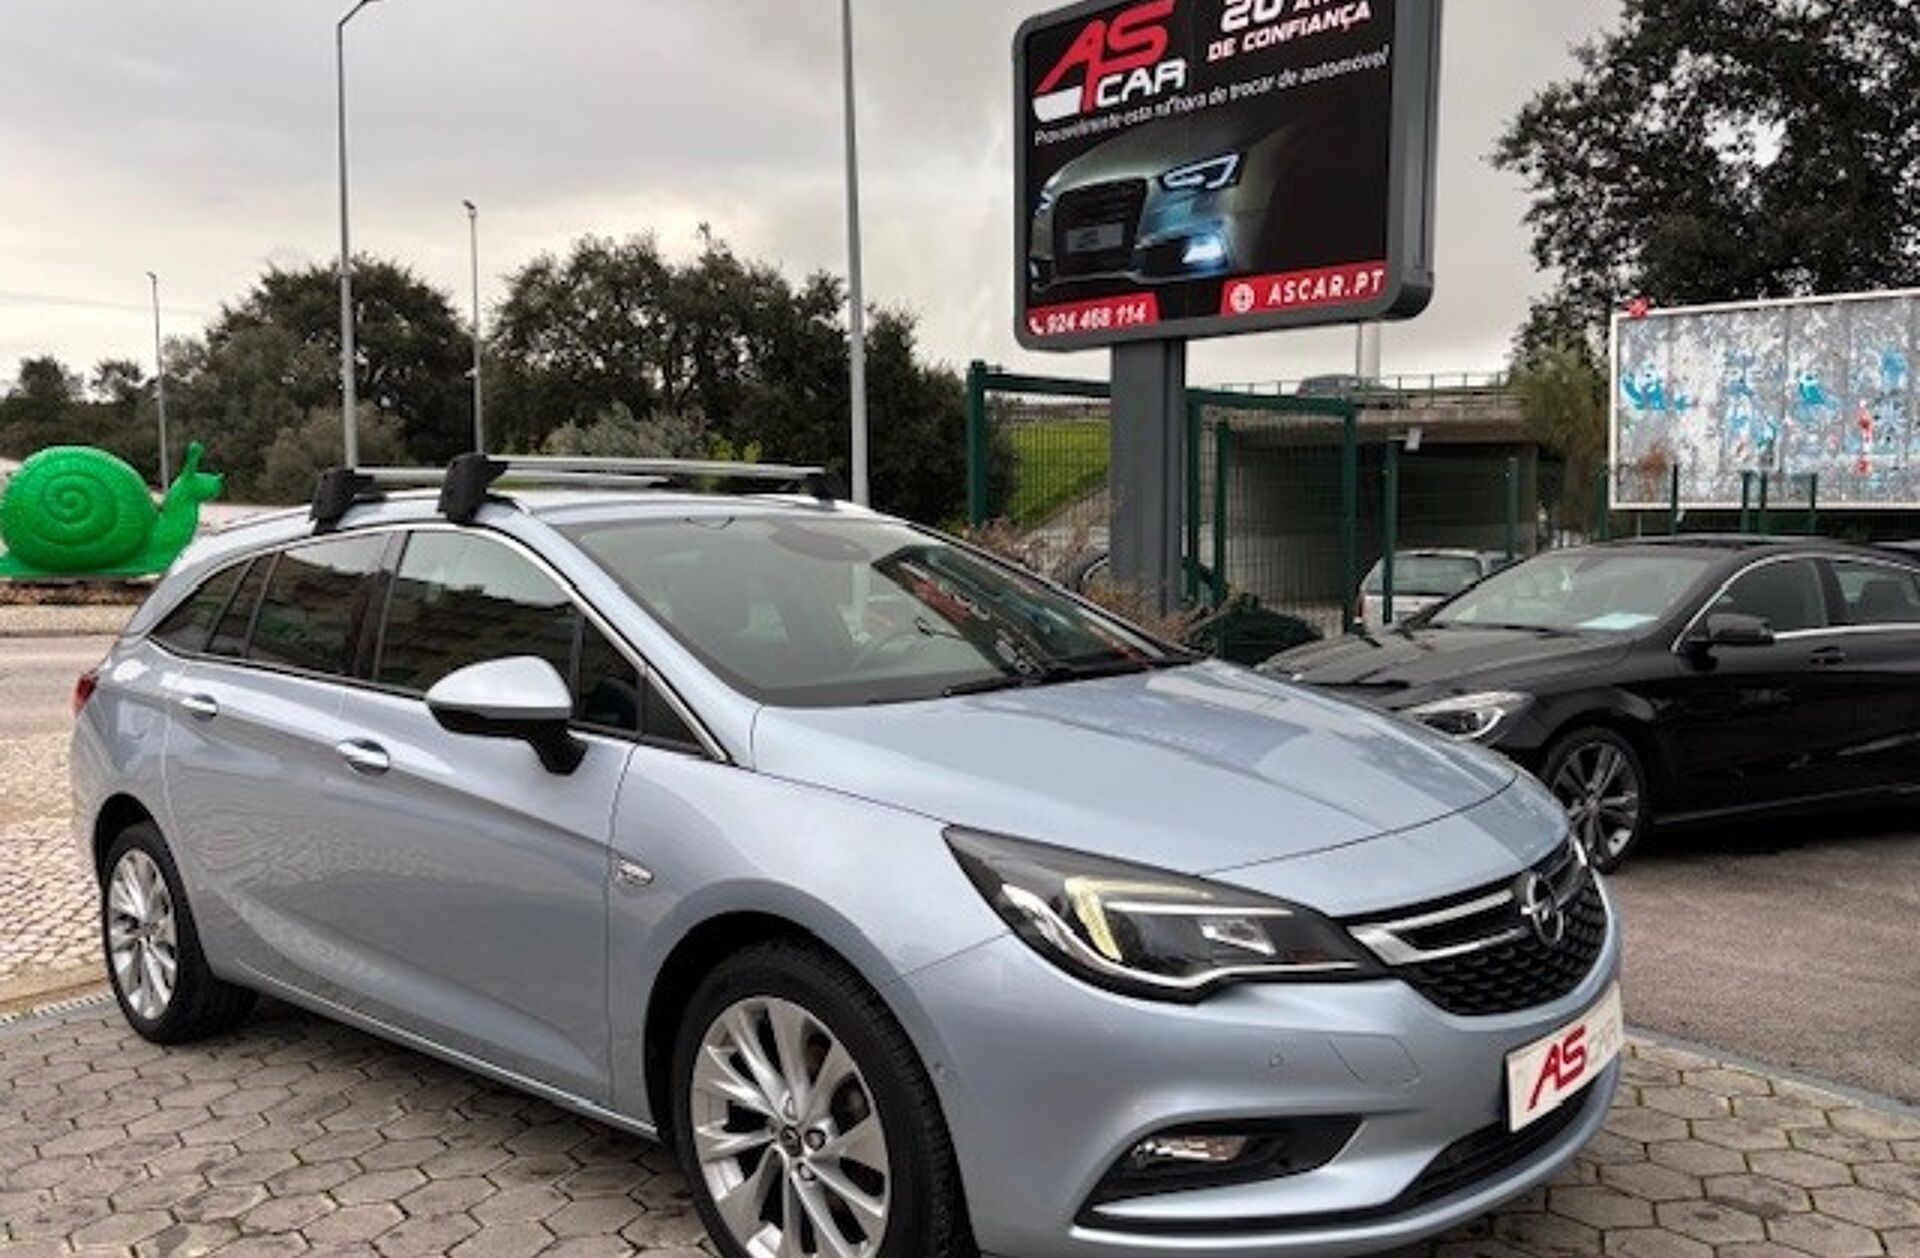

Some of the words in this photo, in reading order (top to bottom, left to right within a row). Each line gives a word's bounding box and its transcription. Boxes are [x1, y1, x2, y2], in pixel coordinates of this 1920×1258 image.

[1038, 0, 1175, 112] AS
[1207, 38, 1237, 63] DE
[1243, 1, 1372, 52] CONFIANÇA
[1096, 58, 1187, 109] CAR
[1208, 86, 1229, 105] de
[1229, 74, 1275, 100] trocar
[1277, 68, 1298, 89] de
[1266, 268, 1385, 306] ASCAR.PT
[1046, 310, 1078, 335] 924
[1116, 301, 1147, 326] 114
[1527, 1024, 1587, 1112] AS
